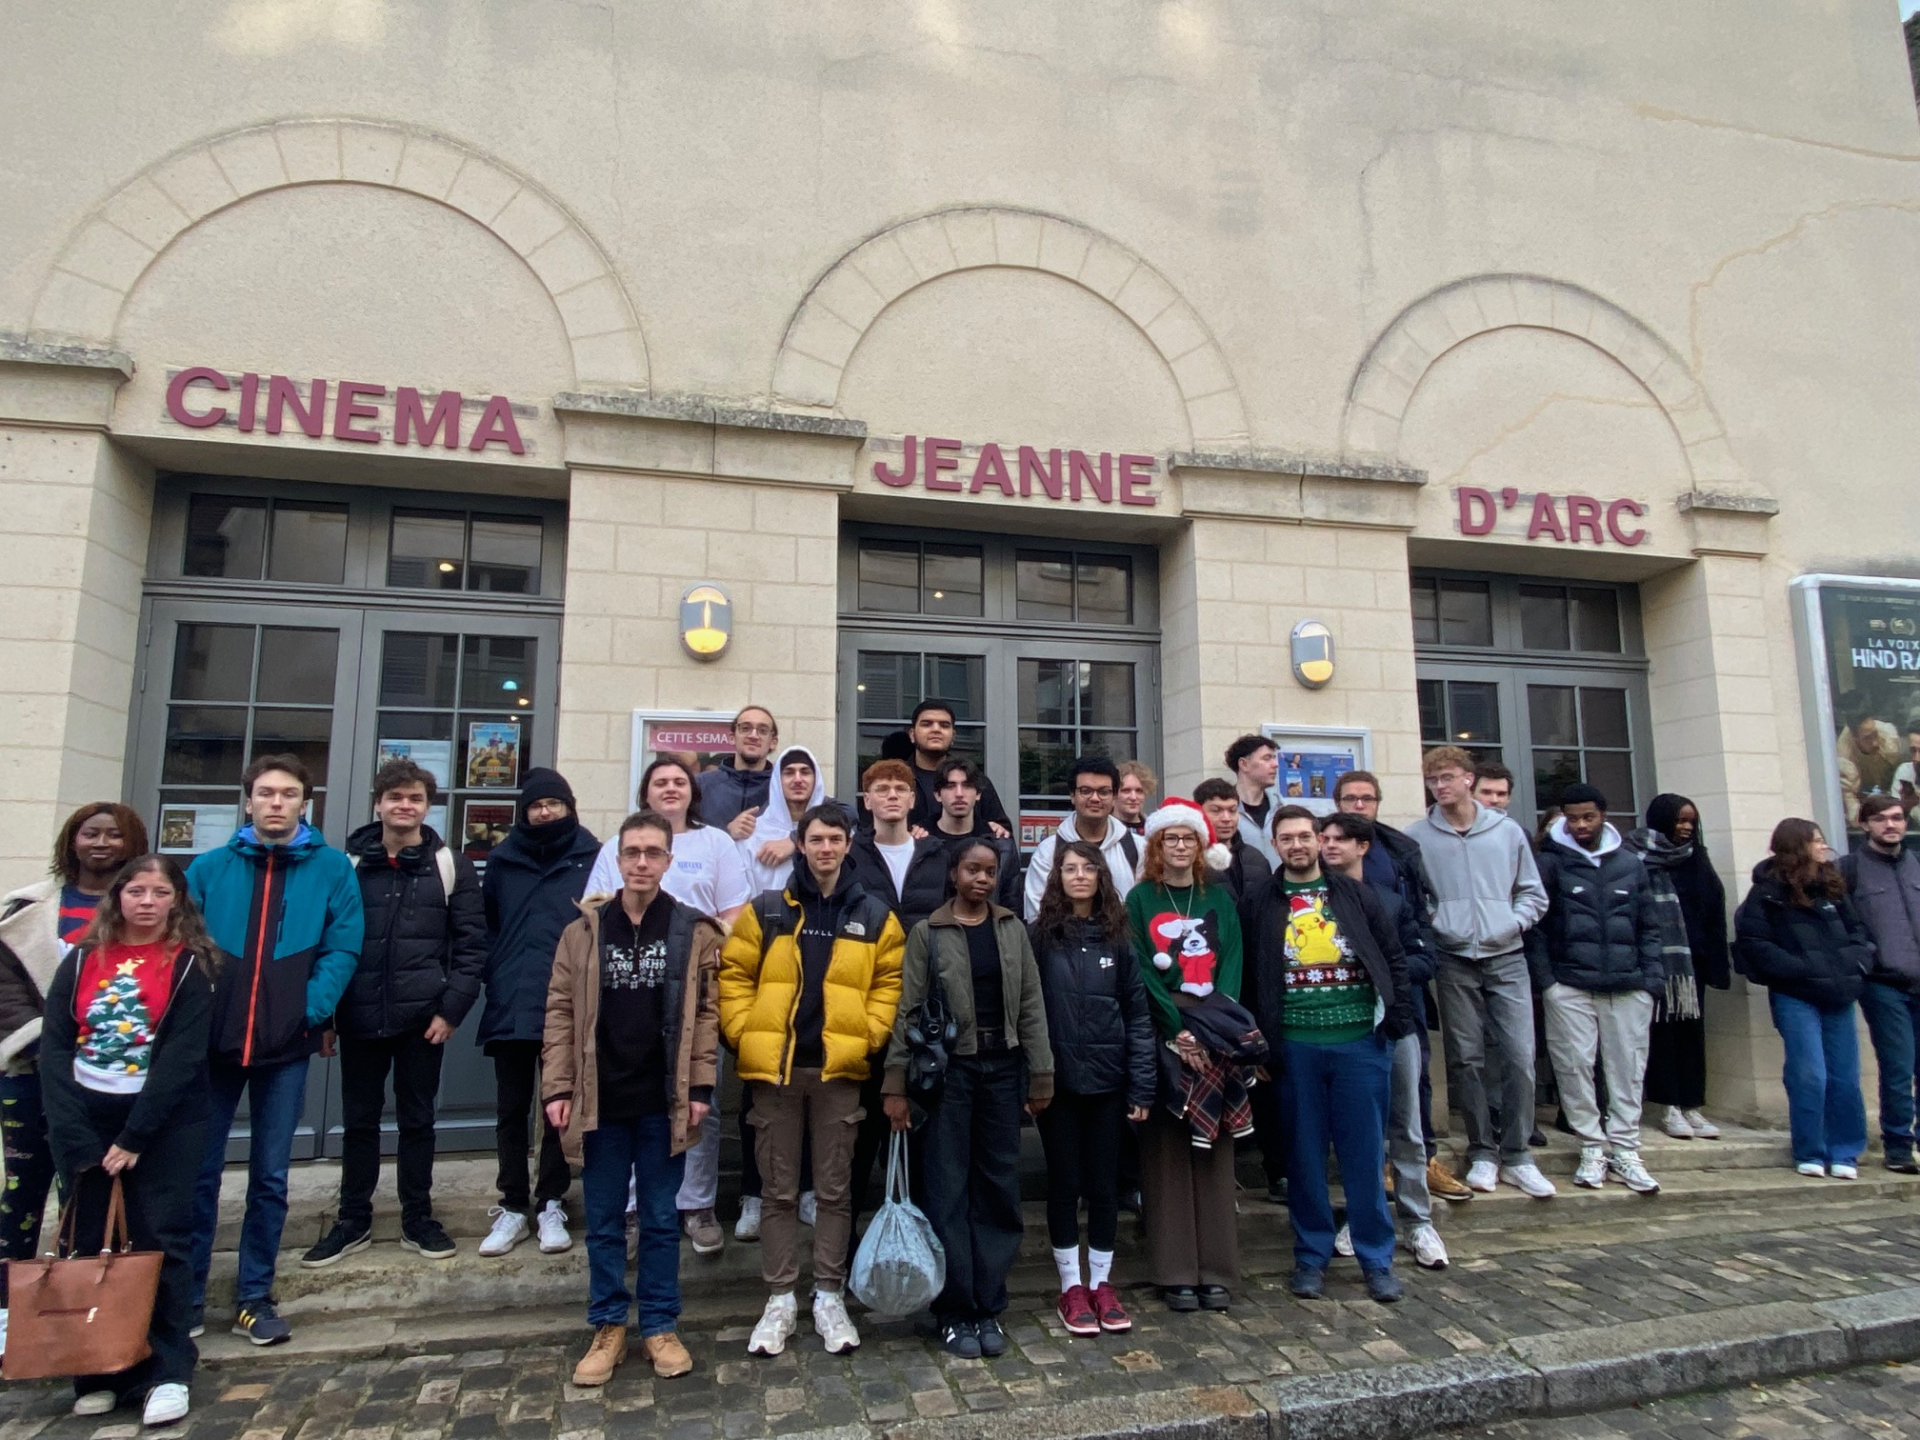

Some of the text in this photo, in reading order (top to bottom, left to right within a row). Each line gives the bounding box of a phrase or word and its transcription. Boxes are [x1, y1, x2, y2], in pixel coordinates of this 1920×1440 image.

[166, 366, 525, 455] CINEMA
[874, 435, 1156, 506] JEANNE
[1459, 486, 1646, 546] D'ARC
[1851, 648, 1898, 669] HIND
[1868, 637, 1920, 650] LA VOIX
[656, 731, 693, 743] CETTE
